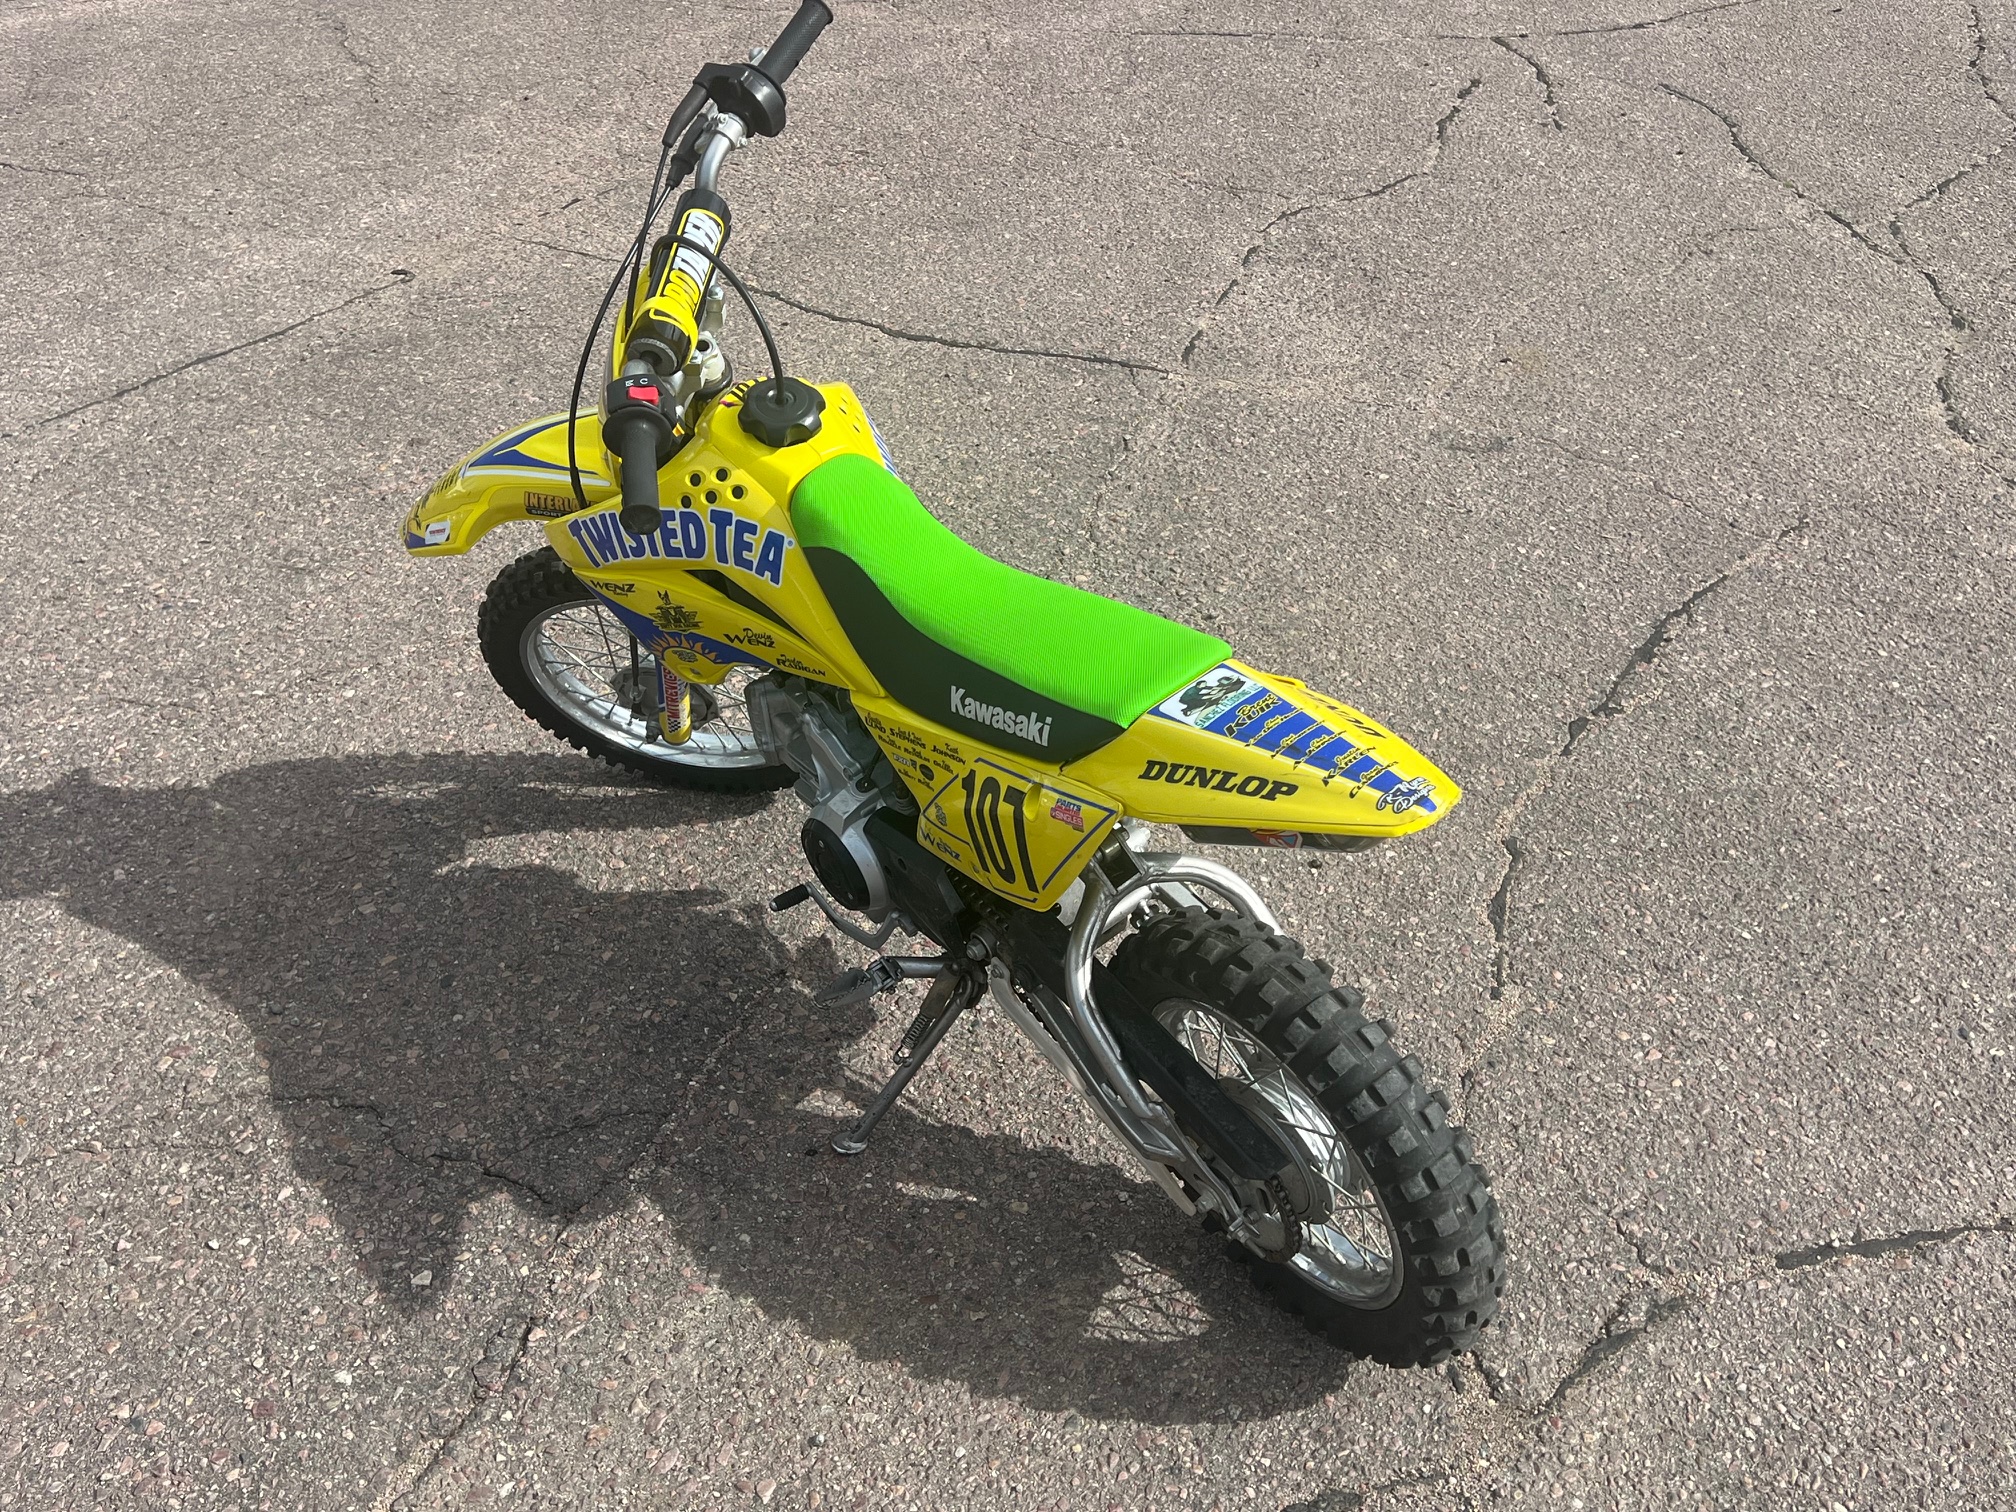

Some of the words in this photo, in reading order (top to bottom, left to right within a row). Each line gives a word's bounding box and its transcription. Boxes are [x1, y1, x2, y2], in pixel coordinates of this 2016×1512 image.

[659, 211, 722, 316] ROTAER
[710, 508, 785, 587] TEA
[590, 580, 636, 593] WENZ
[723, 633, 776, 649] WENZ
[776, 658, 826, 677] RADIGAN
[950, 685, 1052, 747] Kawasaki
[1224, 697, 1281, 736] KUIK
[930, 744, 967, 765] JOHNSON
[1137, 759, 1299, 801] DUNLOP
[961, 768, 1040, 894] 107
